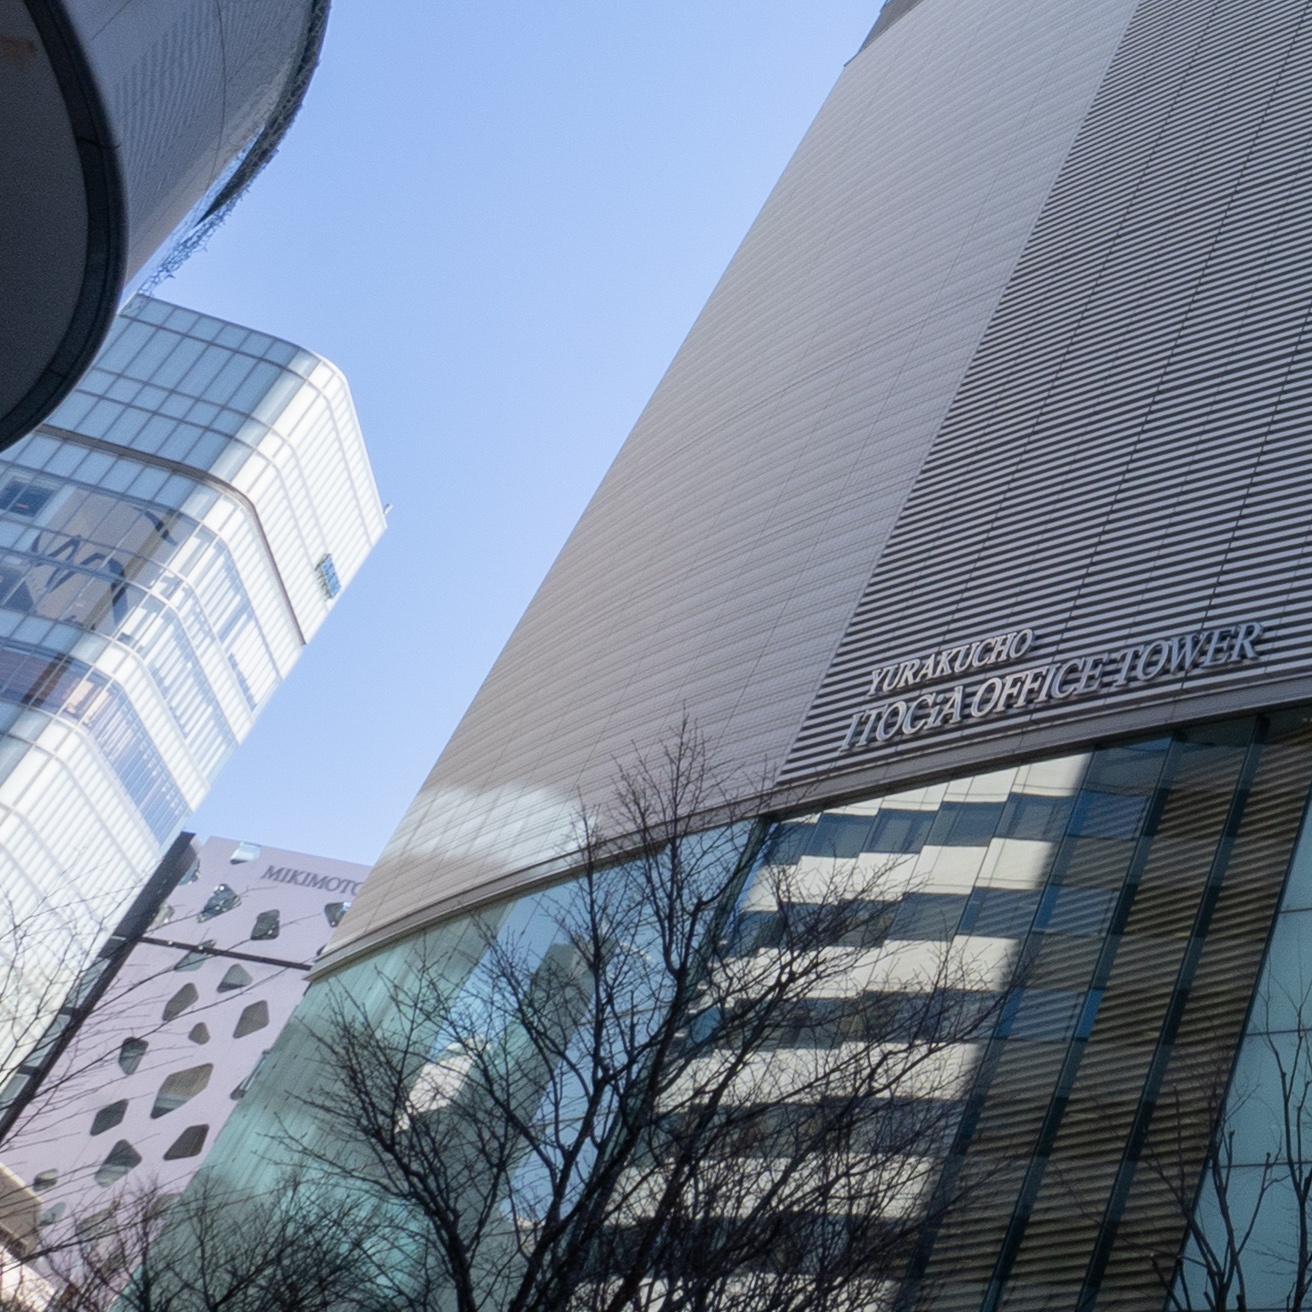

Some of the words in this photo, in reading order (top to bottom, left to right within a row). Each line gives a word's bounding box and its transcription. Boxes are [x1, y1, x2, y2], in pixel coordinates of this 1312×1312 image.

[867, 628, 1035, 696] YURAKUCHO
[970, 657, 1104, 718] OFFICE
[1112, 621, 1264, 687] TOWER
